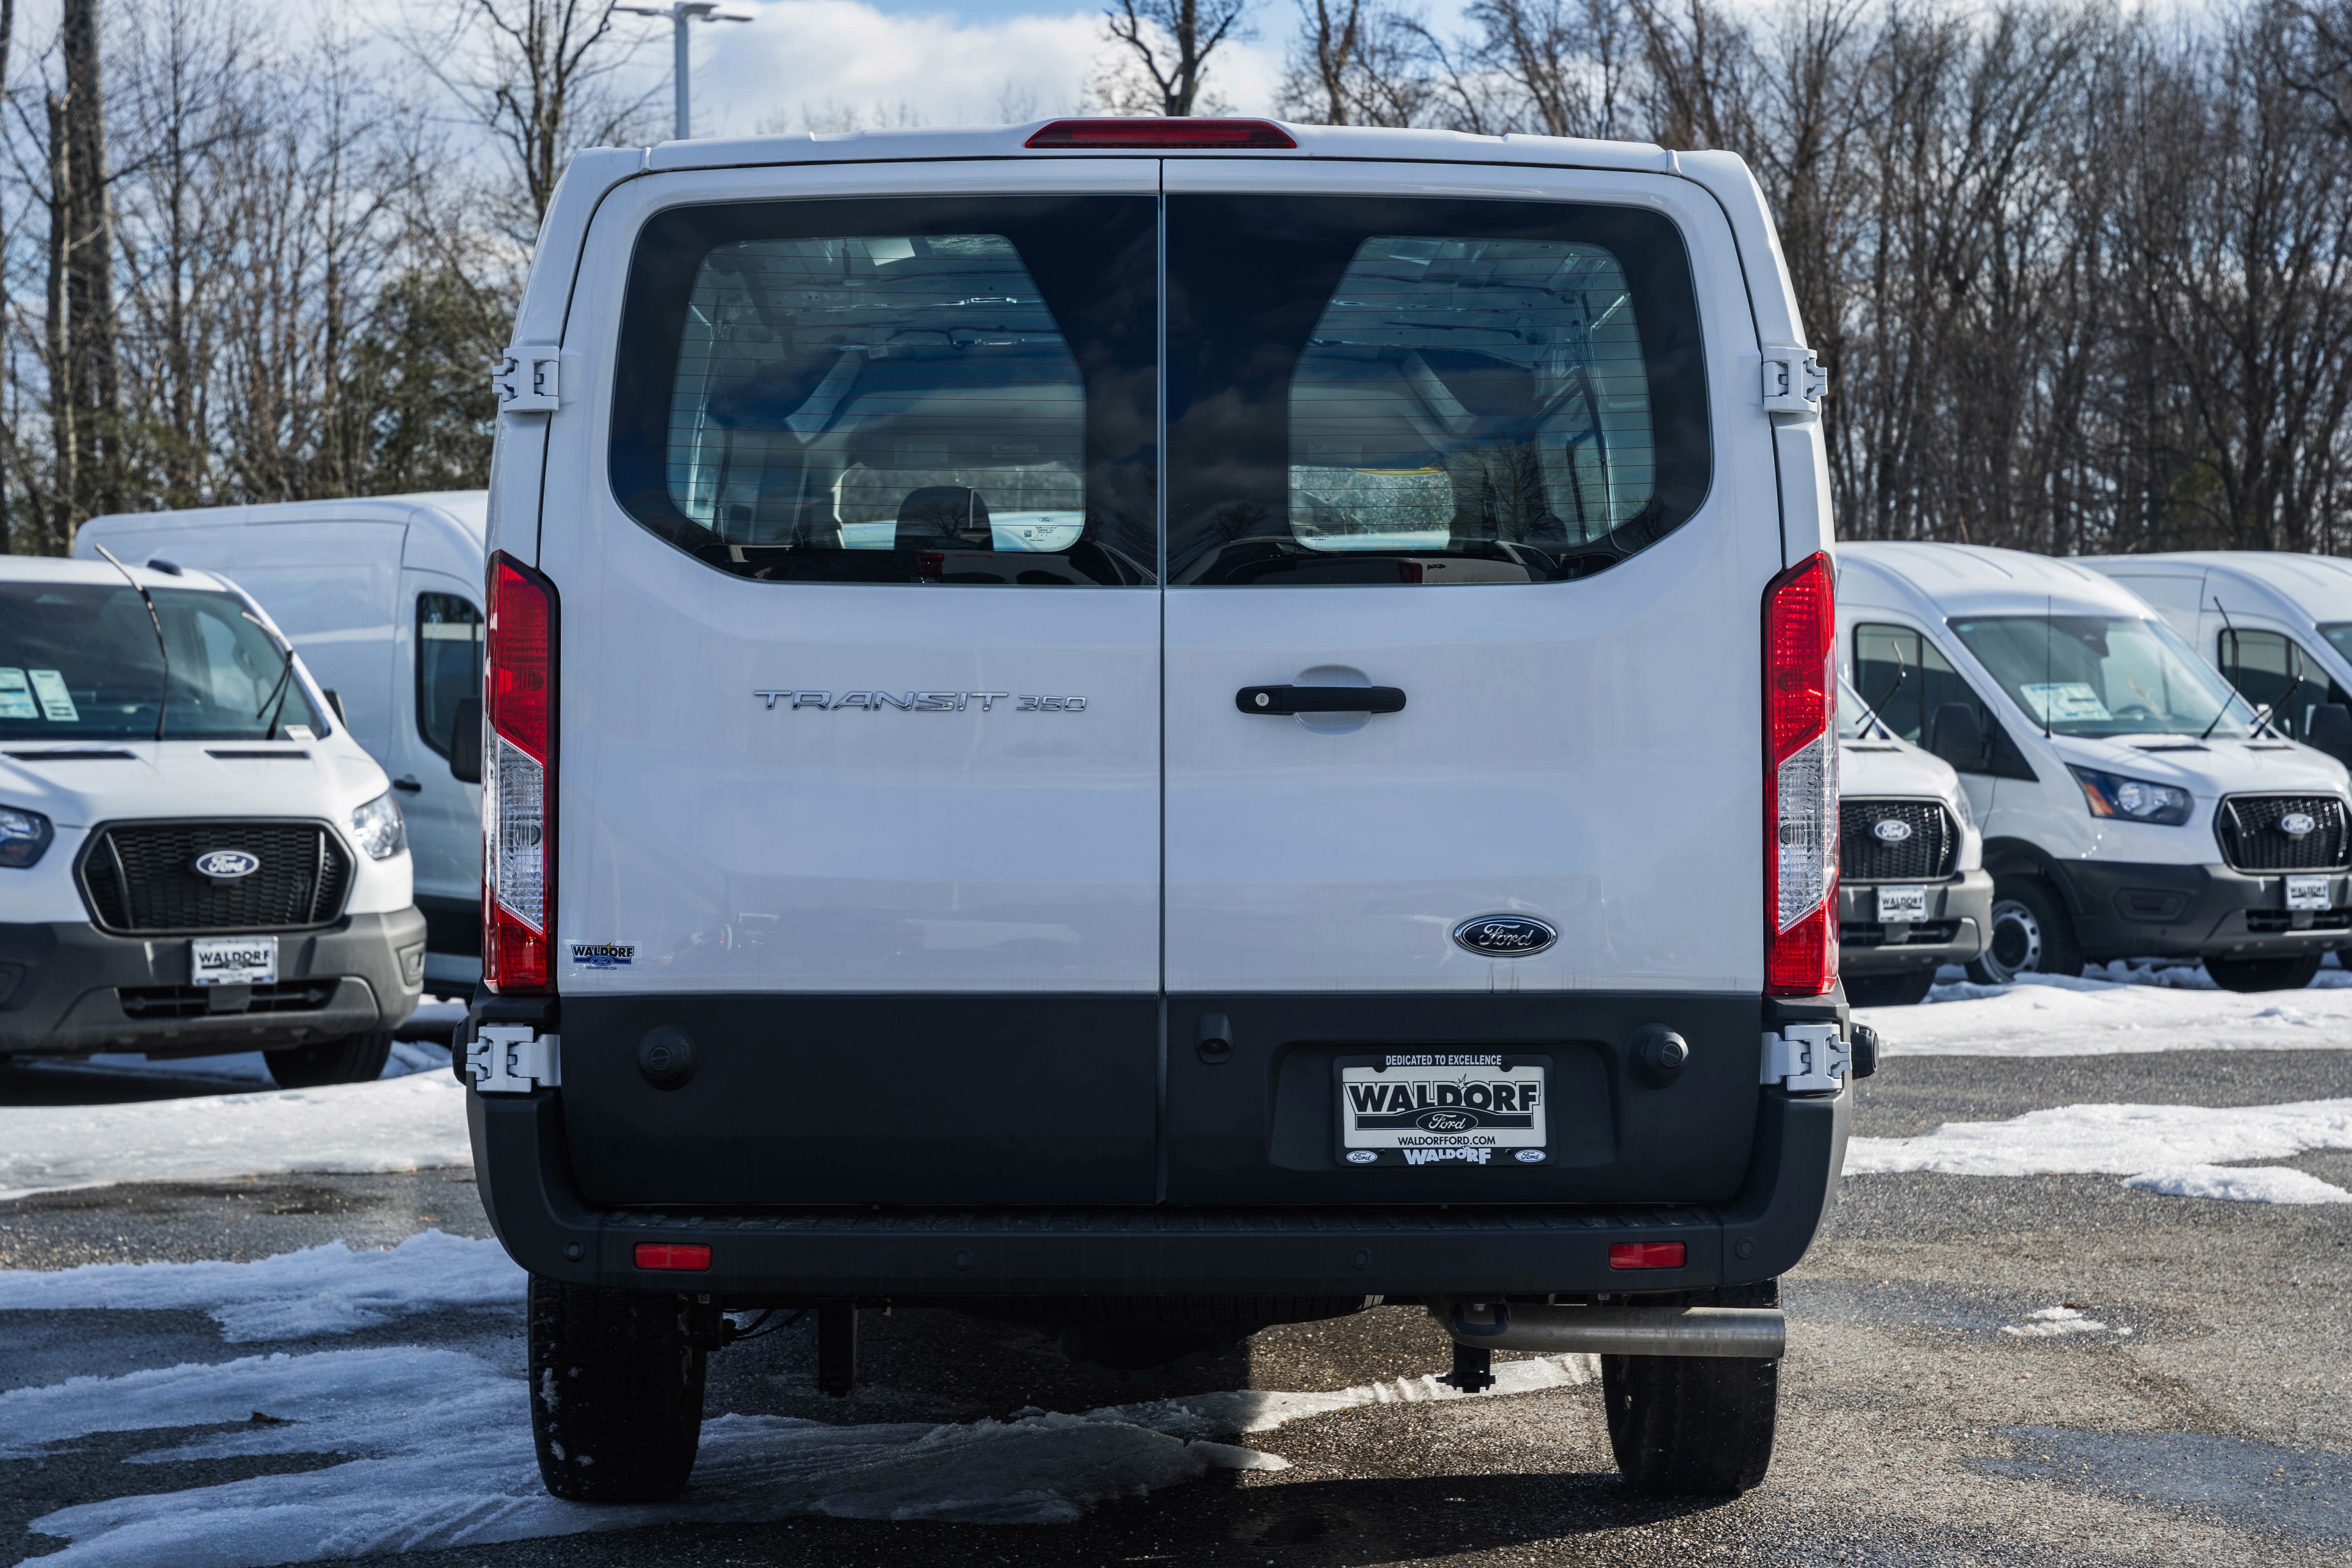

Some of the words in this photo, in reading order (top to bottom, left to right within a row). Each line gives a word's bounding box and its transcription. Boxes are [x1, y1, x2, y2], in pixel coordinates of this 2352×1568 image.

[753, 690, 1009, 711] TRANSIT
[1016, 695, 1087, 712] 350
[1881, 824, 1904, 837] Ford
[208, 854, 247, 873] Ford
[1478, 924, 1534, 946] Ford
[199, 950, 269, 962] WALDORF
[573, 946, 633, 958] WALDORF
[1386, 1055, 1432, 1065] DEDICATED
[1435, 1055, 1446, 1065] TO
[1448, 1055, 1501, 1065] EXCELLENCE
[1348, 1084, 1537, 1112] WALDORF
[1428, 1114, 1466, 1129] Ford
[1398, 1136, 1496, 1145] WALDORFFORD.COM
[1352, 1152, 1371, 1160] Ford
[1403, 1148, 1491, 1165] WALDORF
[1521, 1152, 1540, 1160] Ford
